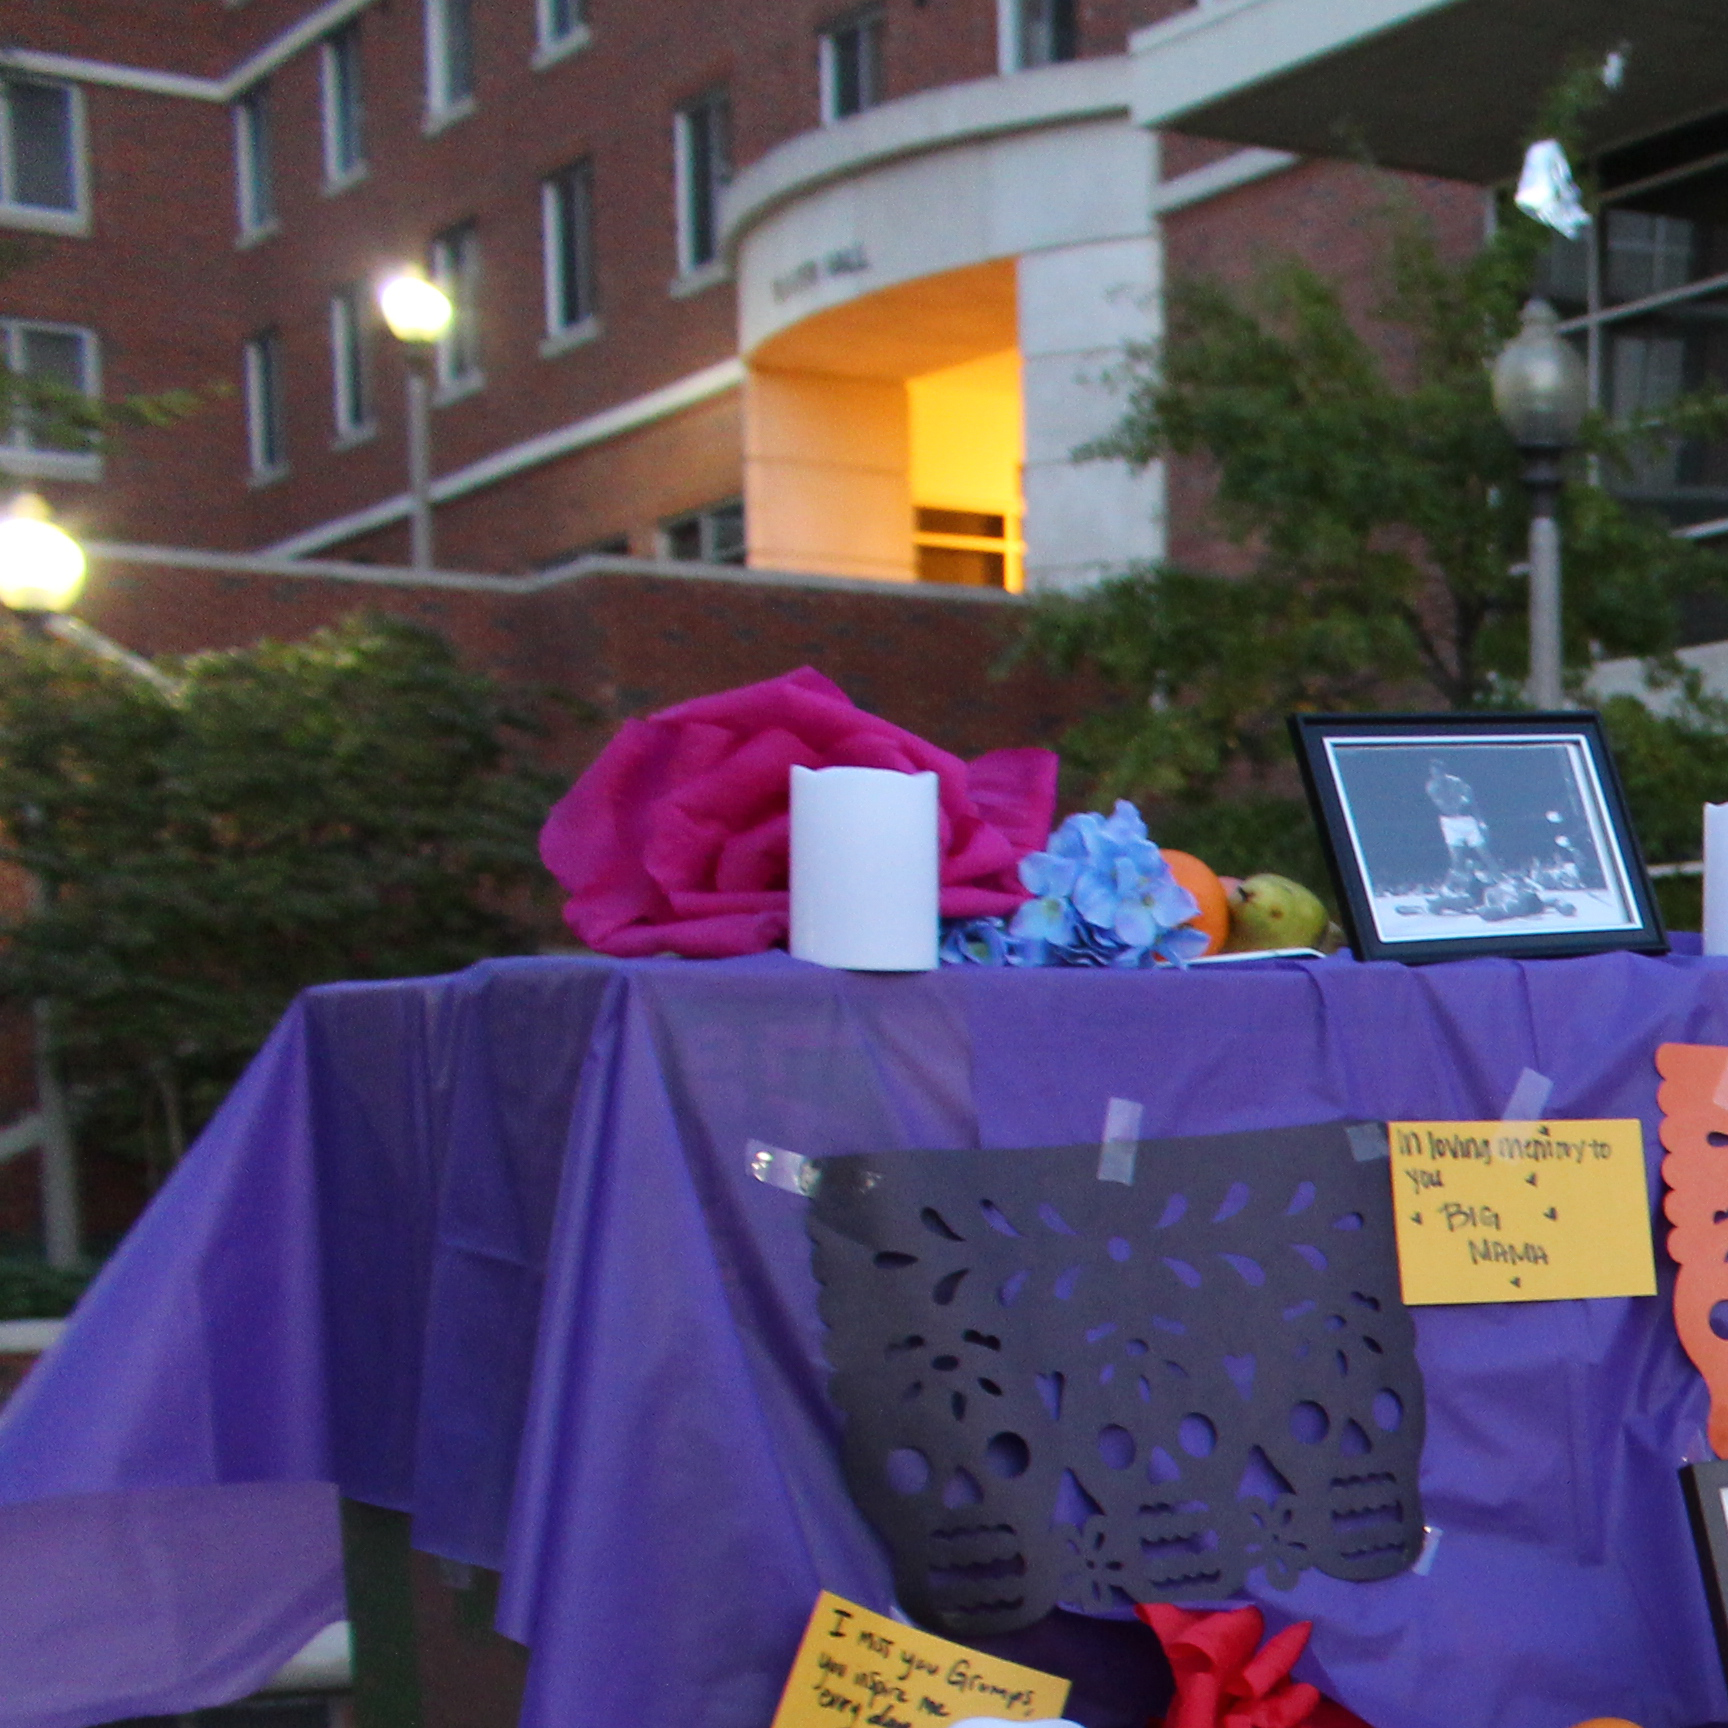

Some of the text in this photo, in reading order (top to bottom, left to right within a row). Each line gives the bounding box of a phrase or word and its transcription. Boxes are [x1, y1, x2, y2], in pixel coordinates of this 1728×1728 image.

[1427, 1131, 1492, 1165] loving
[1438, 1202, 1501, 1232] BIG
[829, 1608, 853, 1637] I
